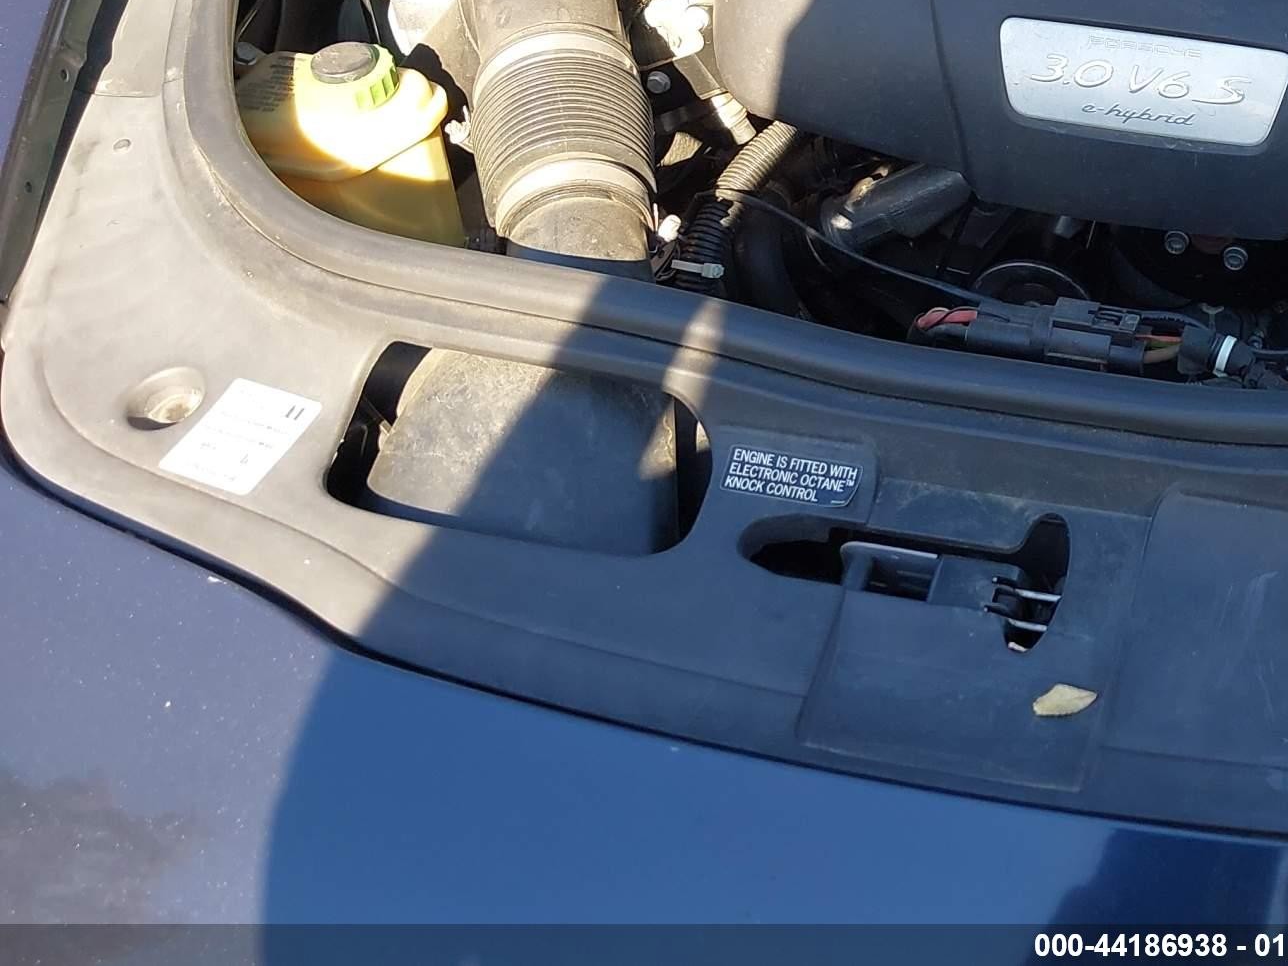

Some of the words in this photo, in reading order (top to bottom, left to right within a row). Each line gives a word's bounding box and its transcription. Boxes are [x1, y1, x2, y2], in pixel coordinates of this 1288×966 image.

[1087, 34, 1202, 59] PORSCHE
[1031, 53, 1114, 89] 3.0
[1129, 64, 1190, 99] V6
[1192, 76, 1252, 105] S
[1082, 103, 1196, 127] e-hybrid
[729, 462, 798, 484] ELECTRONIC
[733, 448, 775, 467] ENGINE
[776, 455, 787, 468] IS
[789, 457, 828, 475] FITTED
[830, 465, 858, 480] WITH
[724, 475, 765, 493] KNOCK
[766, 482, 818, 502] CONTROL
